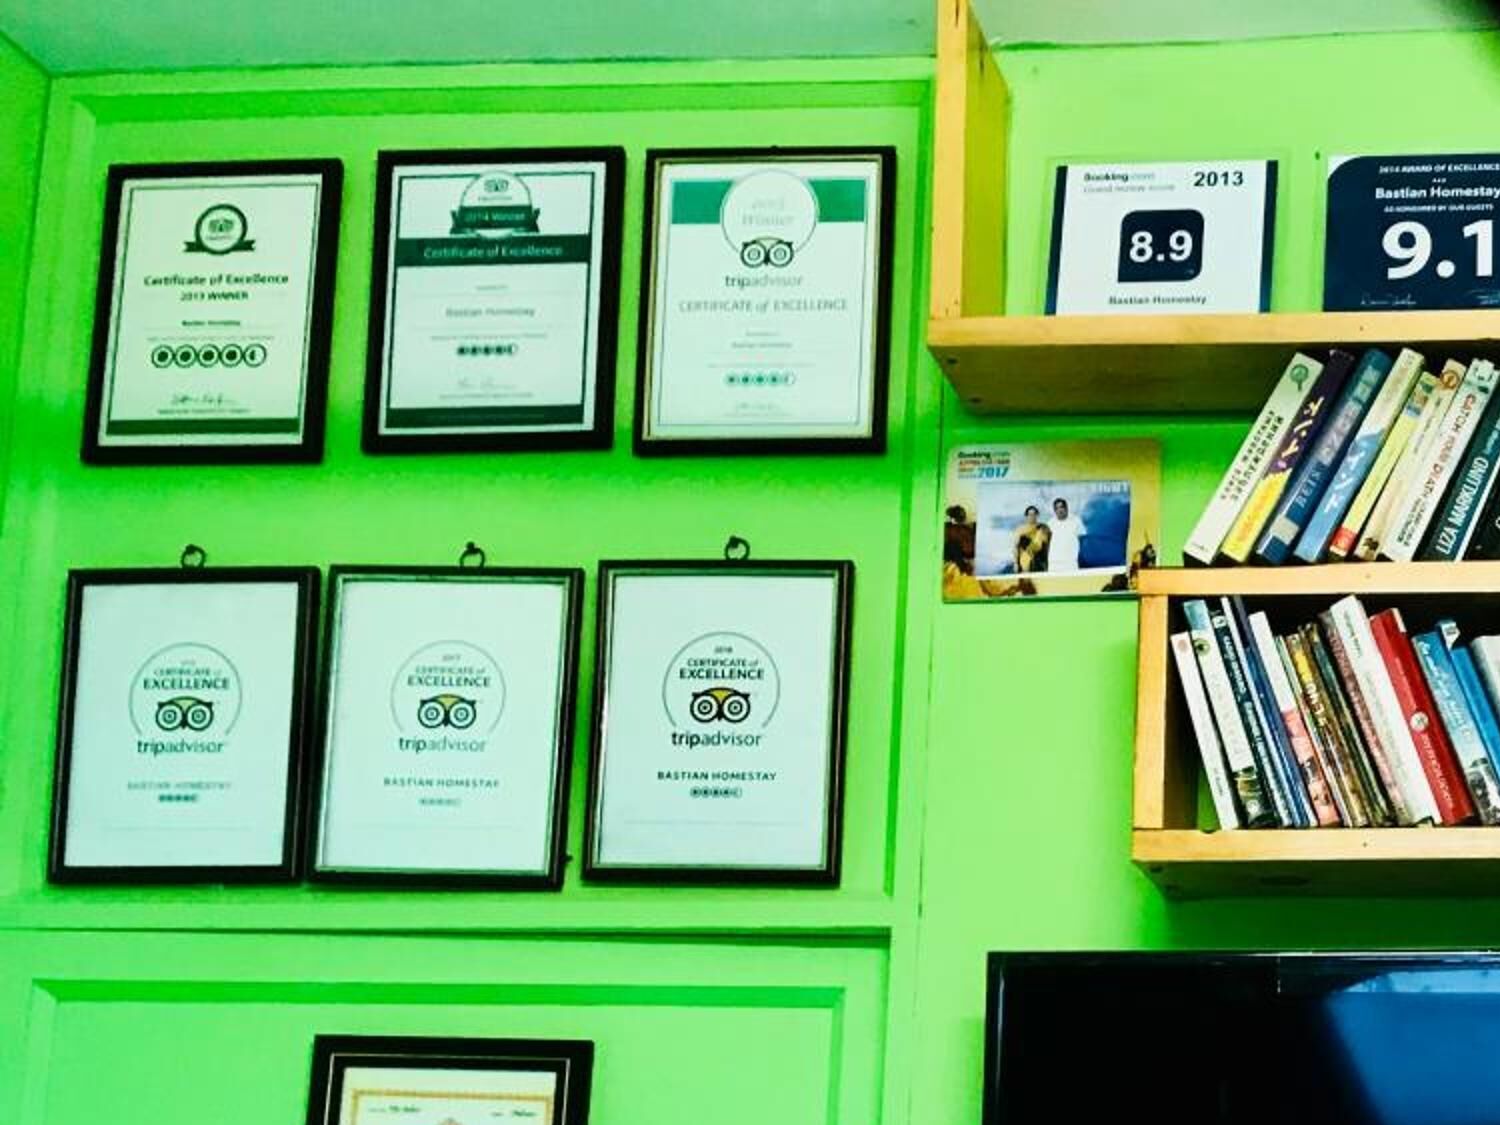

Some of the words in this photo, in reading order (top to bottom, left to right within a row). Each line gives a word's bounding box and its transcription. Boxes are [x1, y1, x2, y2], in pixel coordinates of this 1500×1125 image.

[1193, 170, 1244, 187] 2013
[1375, 187, 1427, 199] Bastian
[424, 246, 485, 259] Certificate
[501, 244, 563, 256] Excellence
[1128, 230, 1193, 263] 8.9
[1381, 219, 1494, 281] 9.1
[143, 273, 206, 287] Certificate
[209, 273, 224, 286] of
[226, 272, 289, 286] Excellence
[725, 275, 803, 290] tripadvisor
[679, 300, 752, 312] CERTIFICATE
[774, 299, 847, 312] EXCELLENCE
[1436, 525, 1457, 555] LIZA
[1448, 457, 1490, 527] MARKLUND
[687, 658, 747, 667] CERTIFICATE
[679, 668, 764, 680] EXCELLENCE
[143, 677, 230, 690] EXCELLENCE
[407, 676, 490, 688] EXCELLENCE
[137, 739, 224, 756] tripadvisor
[398, 736, 487, 754] tripadvisor
[671, 731, 761, 749] tripadvisor
[383, 778, 433, 787] BASTIAN
[657, 771, 709, 781] BASTIAN
[711, 771, 777, 781] HOMESTAY
